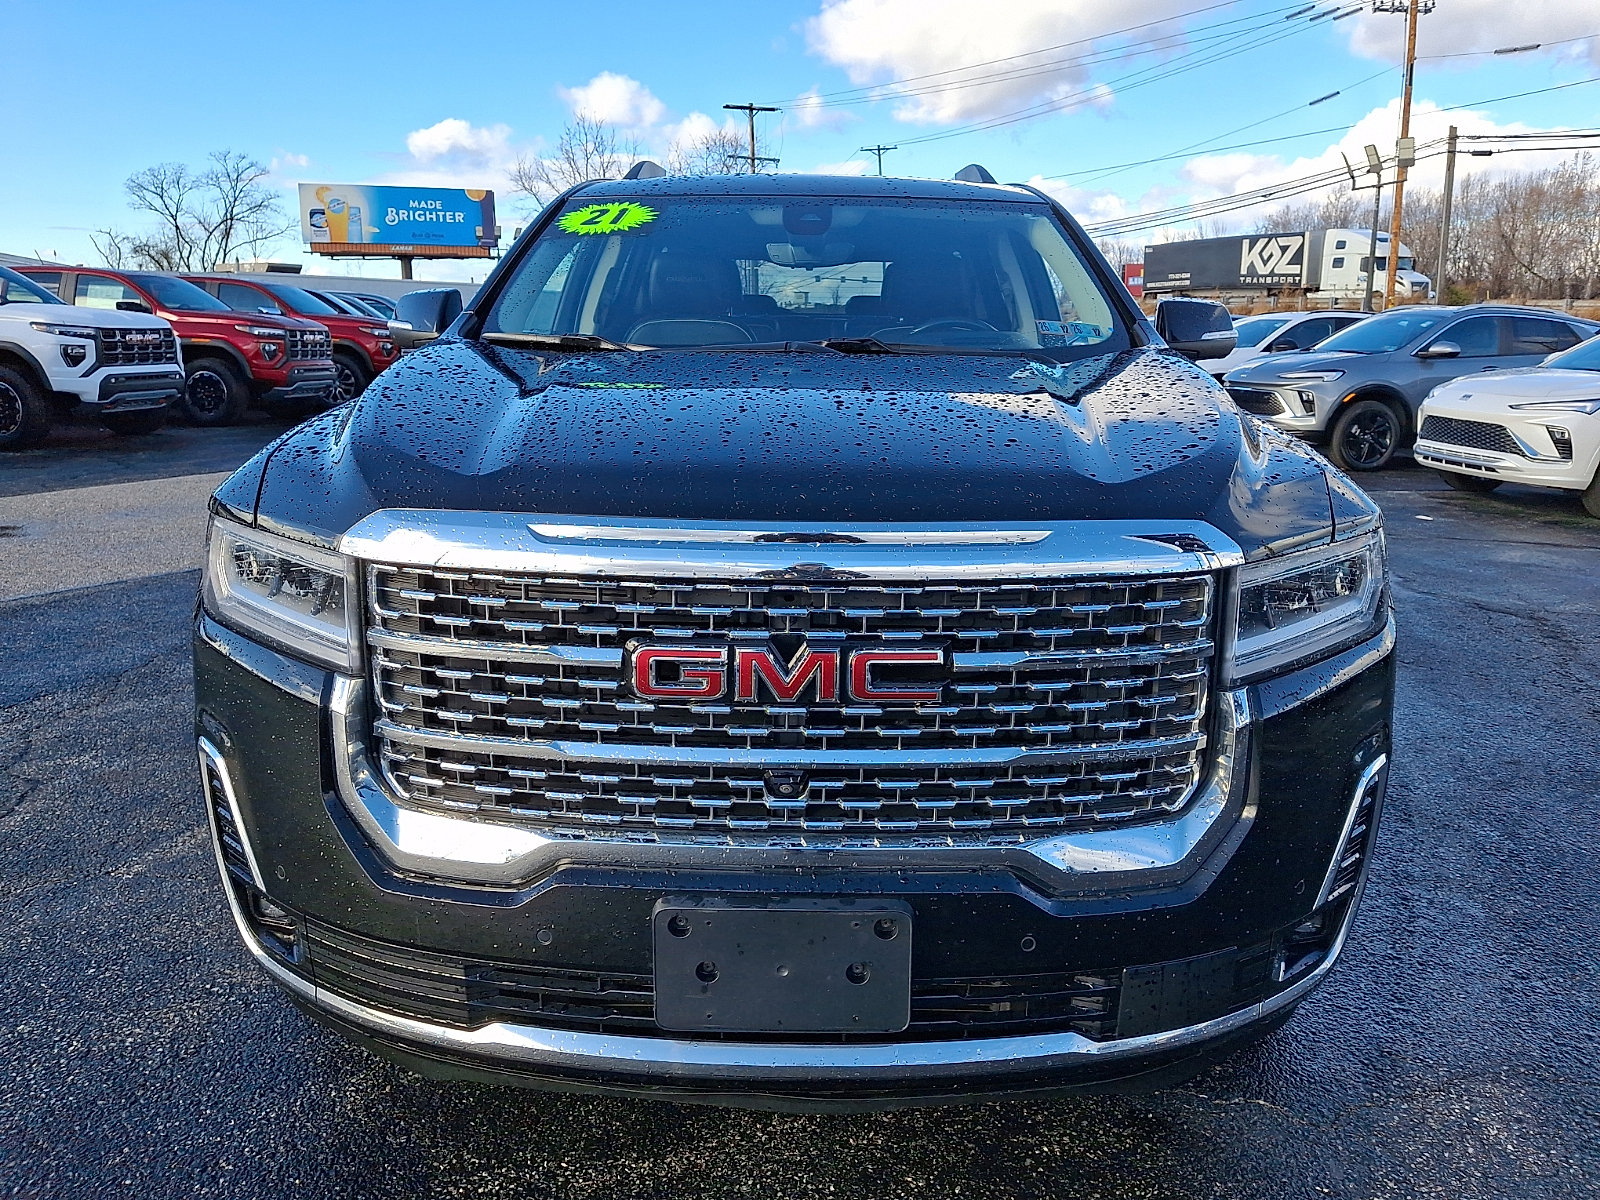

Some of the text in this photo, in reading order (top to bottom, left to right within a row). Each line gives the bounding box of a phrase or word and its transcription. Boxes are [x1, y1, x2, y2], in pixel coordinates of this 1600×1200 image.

[410, 200, 443, 209] MADE
[385, 208, 464, 225] BRIGHTER
[580, 208, 631, 226] 21
[1240, 235, 1303, 274] KOZ
[126, 334, 160, 344] GMC
[634, 643, 944, 703] GMC
